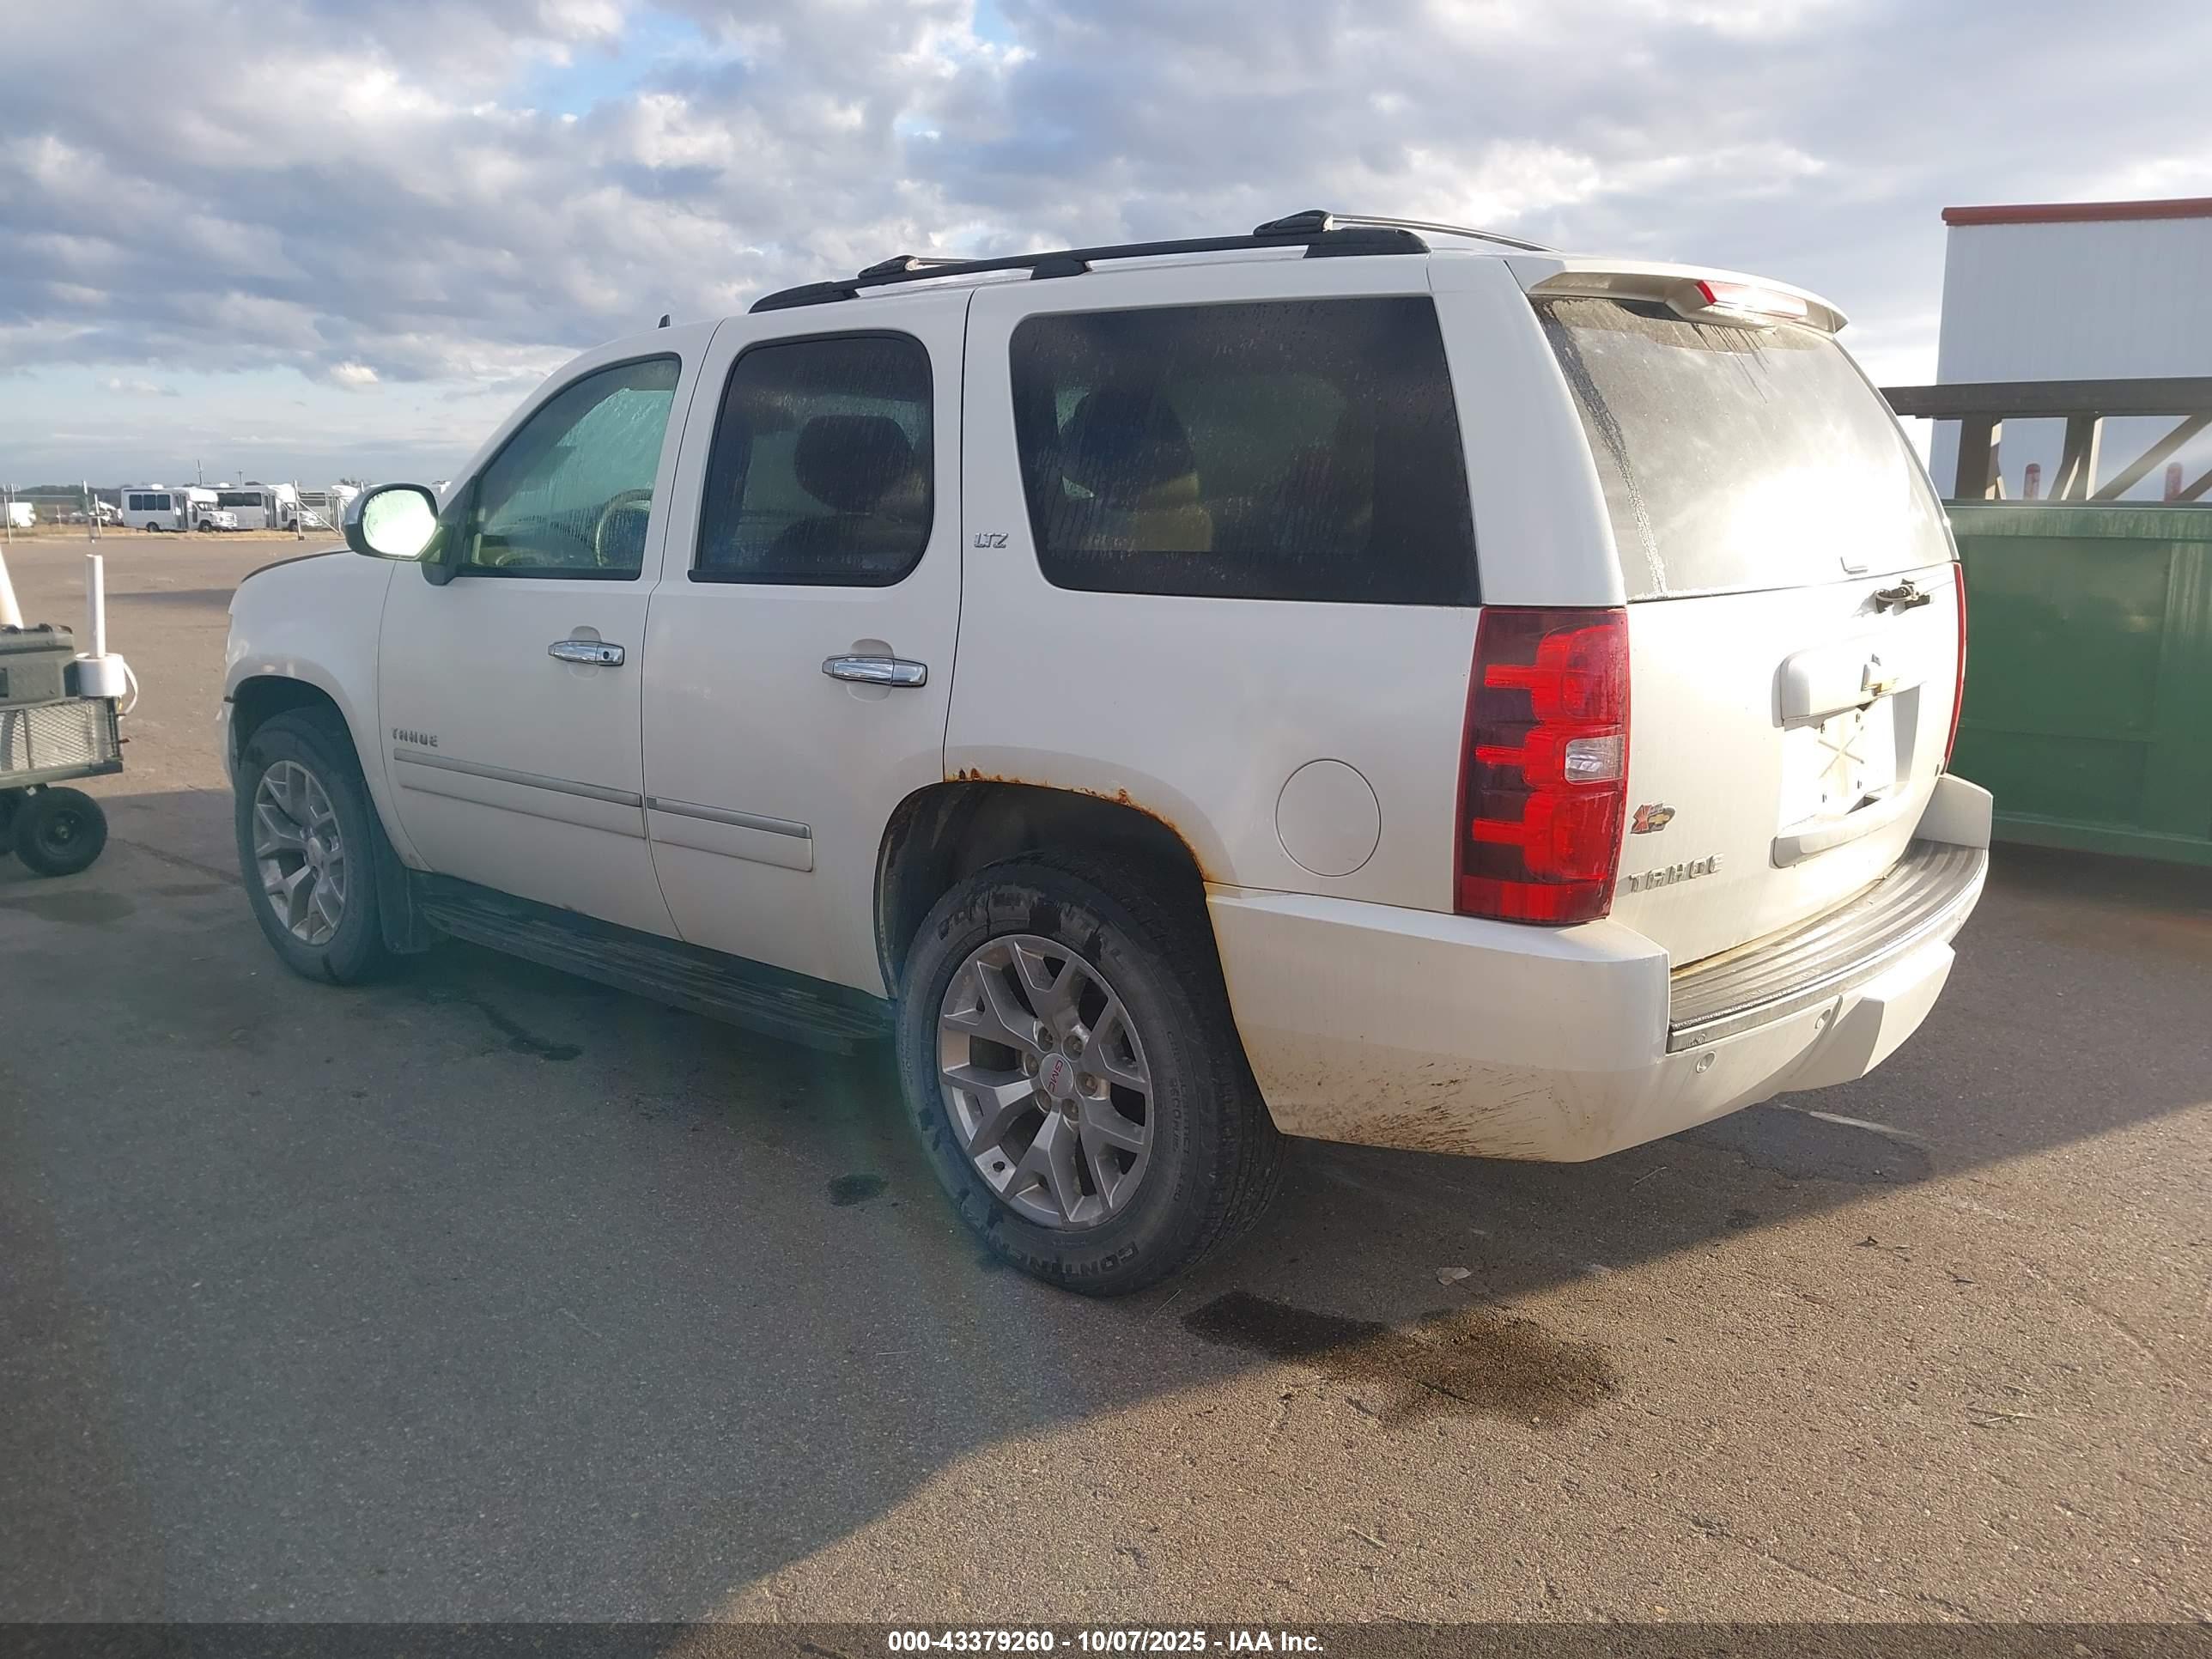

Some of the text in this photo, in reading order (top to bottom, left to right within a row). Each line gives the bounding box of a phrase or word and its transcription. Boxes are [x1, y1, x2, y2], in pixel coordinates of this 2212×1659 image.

[974, 532, 1009, 549] LTZ
[1628, 853, 1724, 893] TAHOE
[1048, 1059, 1064, 1093] GMC
